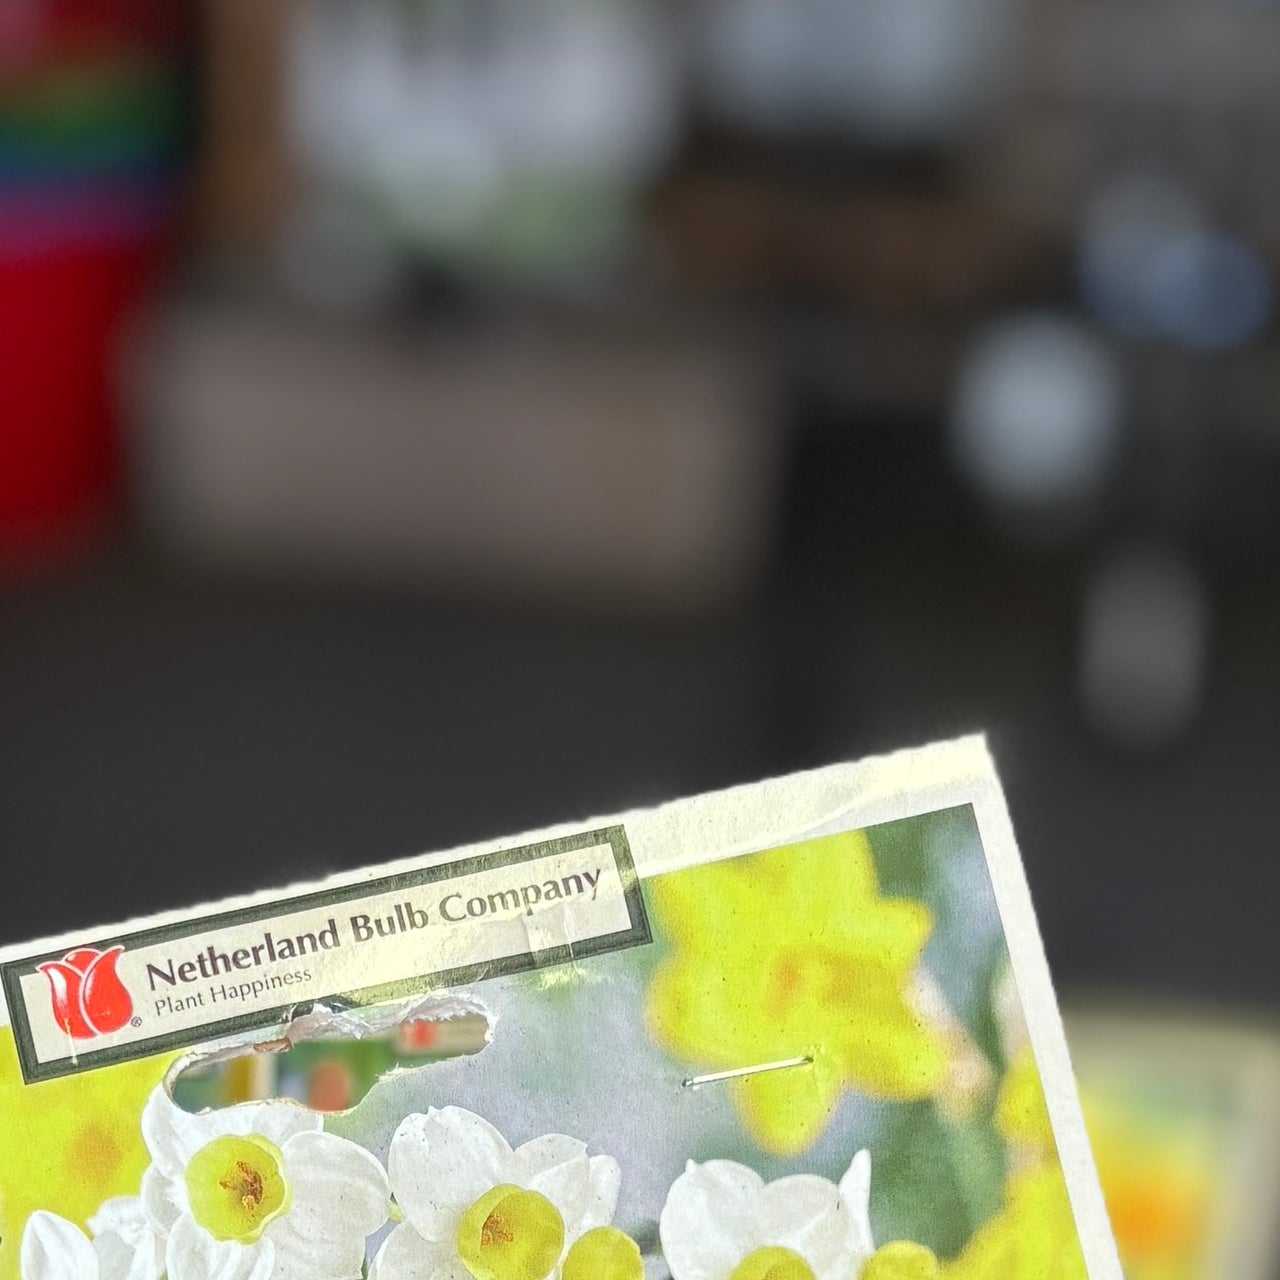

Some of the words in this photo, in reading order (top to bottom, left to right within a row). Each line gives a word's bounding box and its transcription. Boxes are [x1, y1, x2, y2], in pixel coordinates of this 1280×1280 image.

[147, 918, 342, 990] Netherland
[351, 900, 429, 943] Bulb
[439, 868, 603, 923] Company
[155, 989, 206, 1017] Plant
[210, 966, 313, 1010] Happiness
